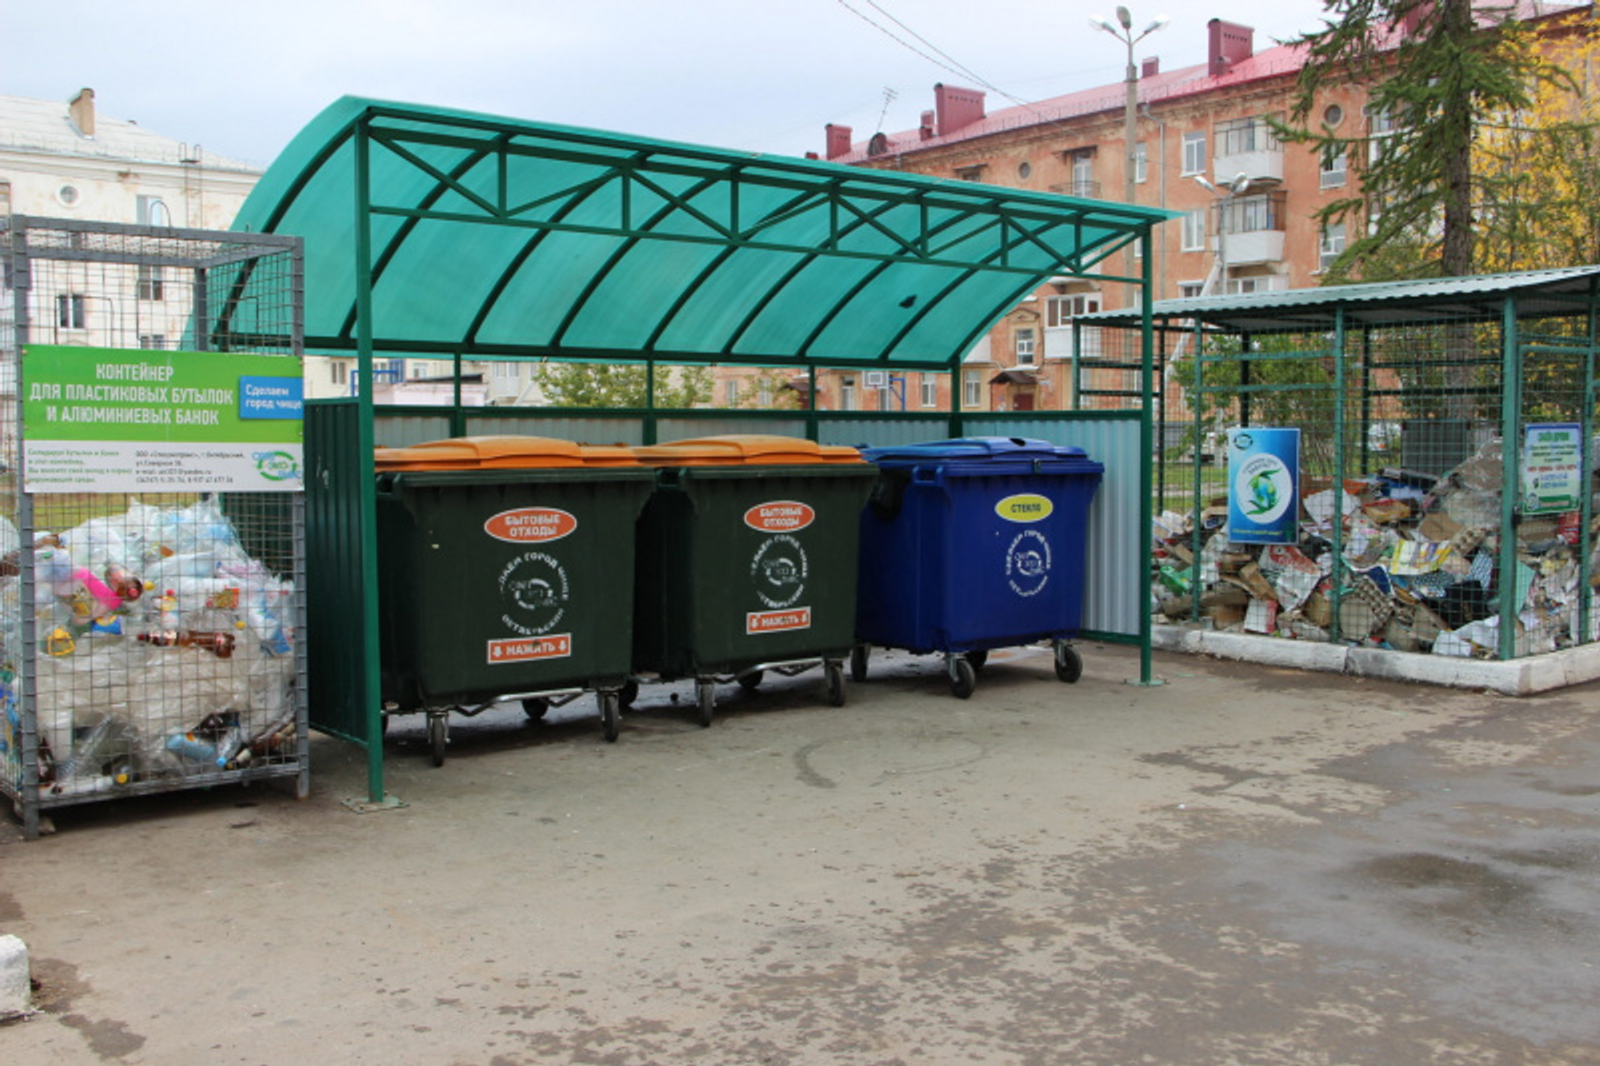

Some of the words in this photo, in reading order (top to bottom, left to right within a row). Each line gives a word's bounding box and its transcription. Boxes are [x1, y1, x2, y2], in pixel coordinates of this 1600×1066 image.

[96, 361, 175, 382] КОНТЕЙНЕР
[30, 383, 61, 401] ДЛЯ
[65, 385, 168, 404] ПЛАСТИКОВЫХ
[171, 387, 234, 405] БУТЫЛОК
[245, 383, 290, 398] Сделаем
[245, 399, 275, 410] город
[276, 400, 302, 410] чище
[46, 406, 57, 421] И
[61, 406, 172, 424] АЛЮМИНИЕВЫХ
[175, 409, 220, 425] БАНОК
[760, 507, 803, 517] БЫТОВЫЕ
[1010, 503, 1042, 513] СТЕКЛО
[504, 513, 561, 526] БЫТОВЫЕ
[763, 517, 800, 527] ОТХОДЫ
[510, 526, 558, 537] ОТХОДЫ
[524, 552, 558, 570] ГОРОД
[762, 614, 800, 627] НАЖАТЬ
[506, 641, 556, 656] НАЖАТЬ
